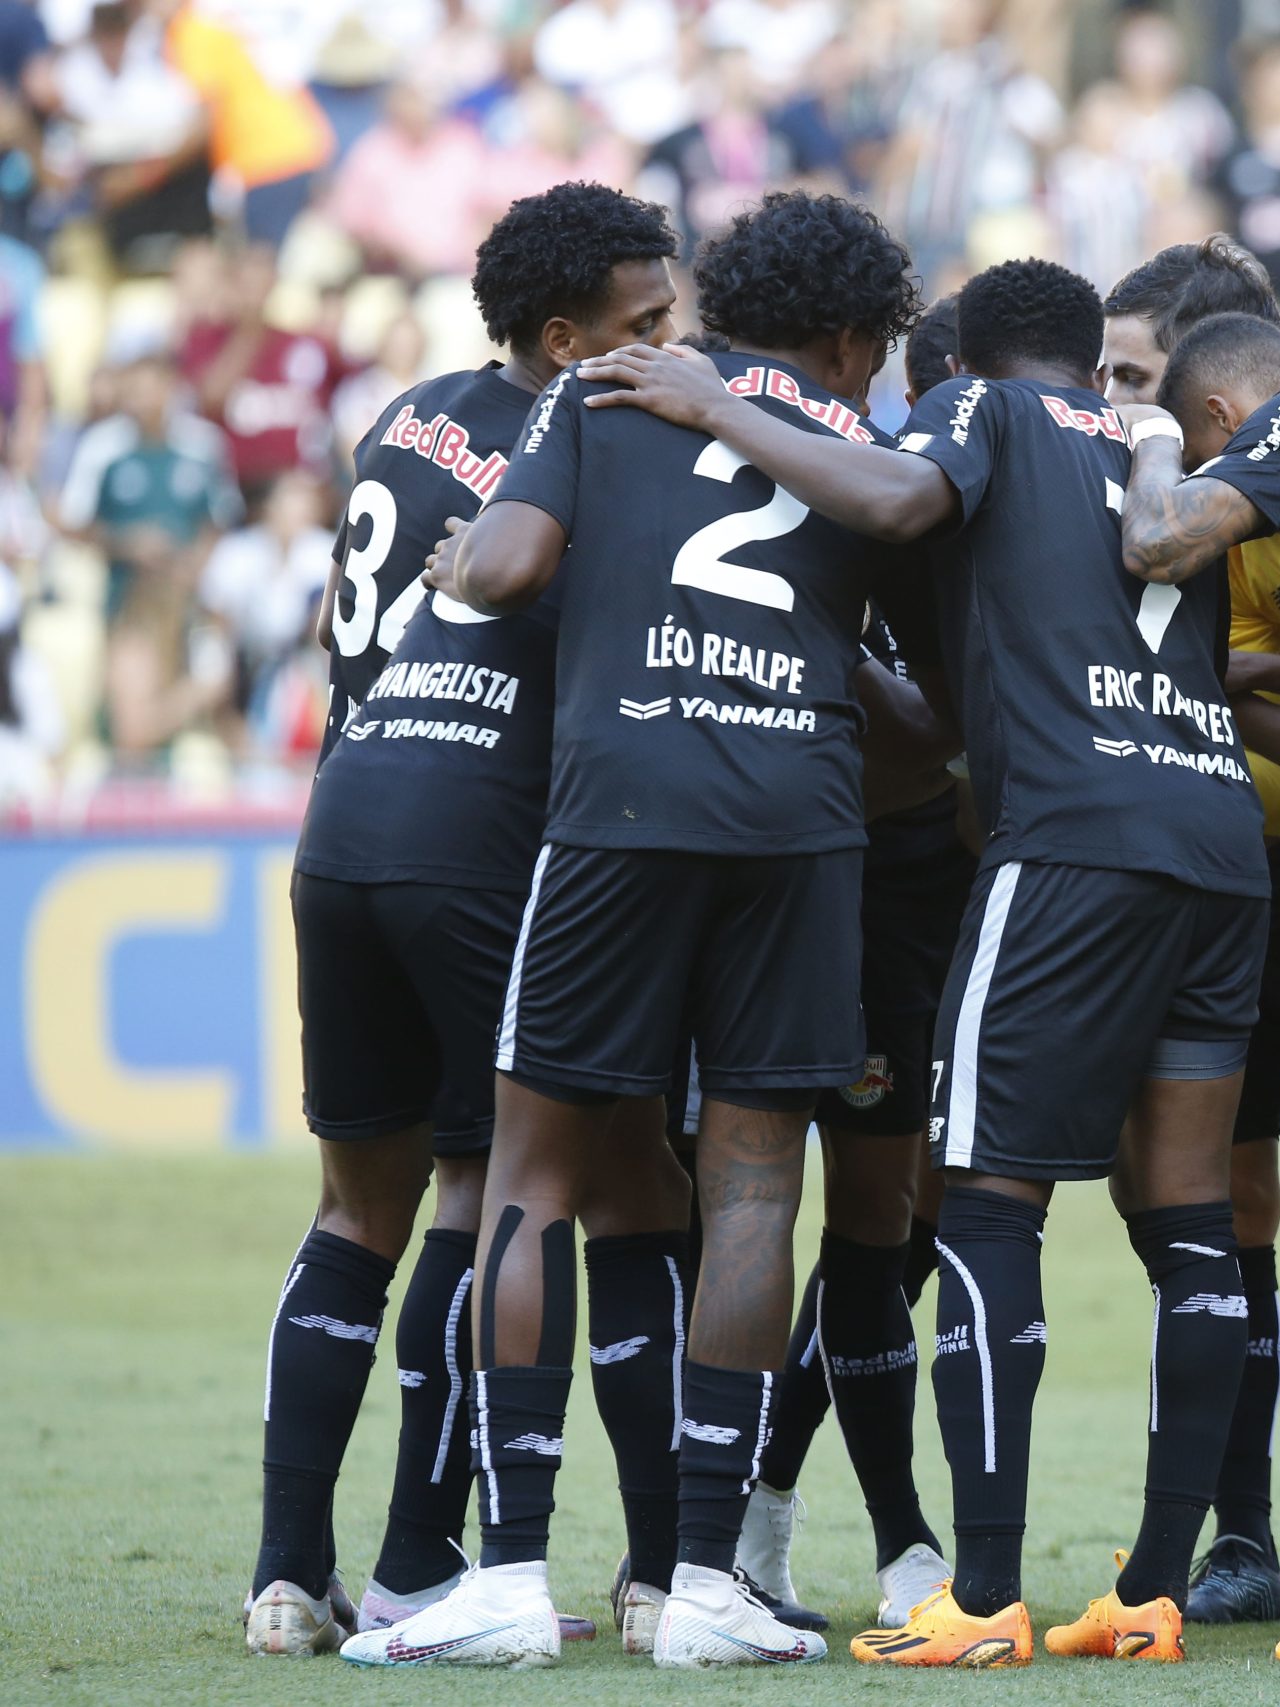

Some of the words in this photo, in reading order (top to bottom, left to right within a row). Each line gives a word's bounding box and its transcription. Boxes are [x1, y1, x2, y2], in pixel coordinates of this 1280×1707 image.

[671, 439, 810, 613] 2
[646, 614, 696, 668] LÉO
[701, 633, 805, 694] REALPE
[1088, 665, 1145, 712] ERIC
[382, 718, 501, 749] YANMAR
[678, 697, 816, 733] YANMAR
